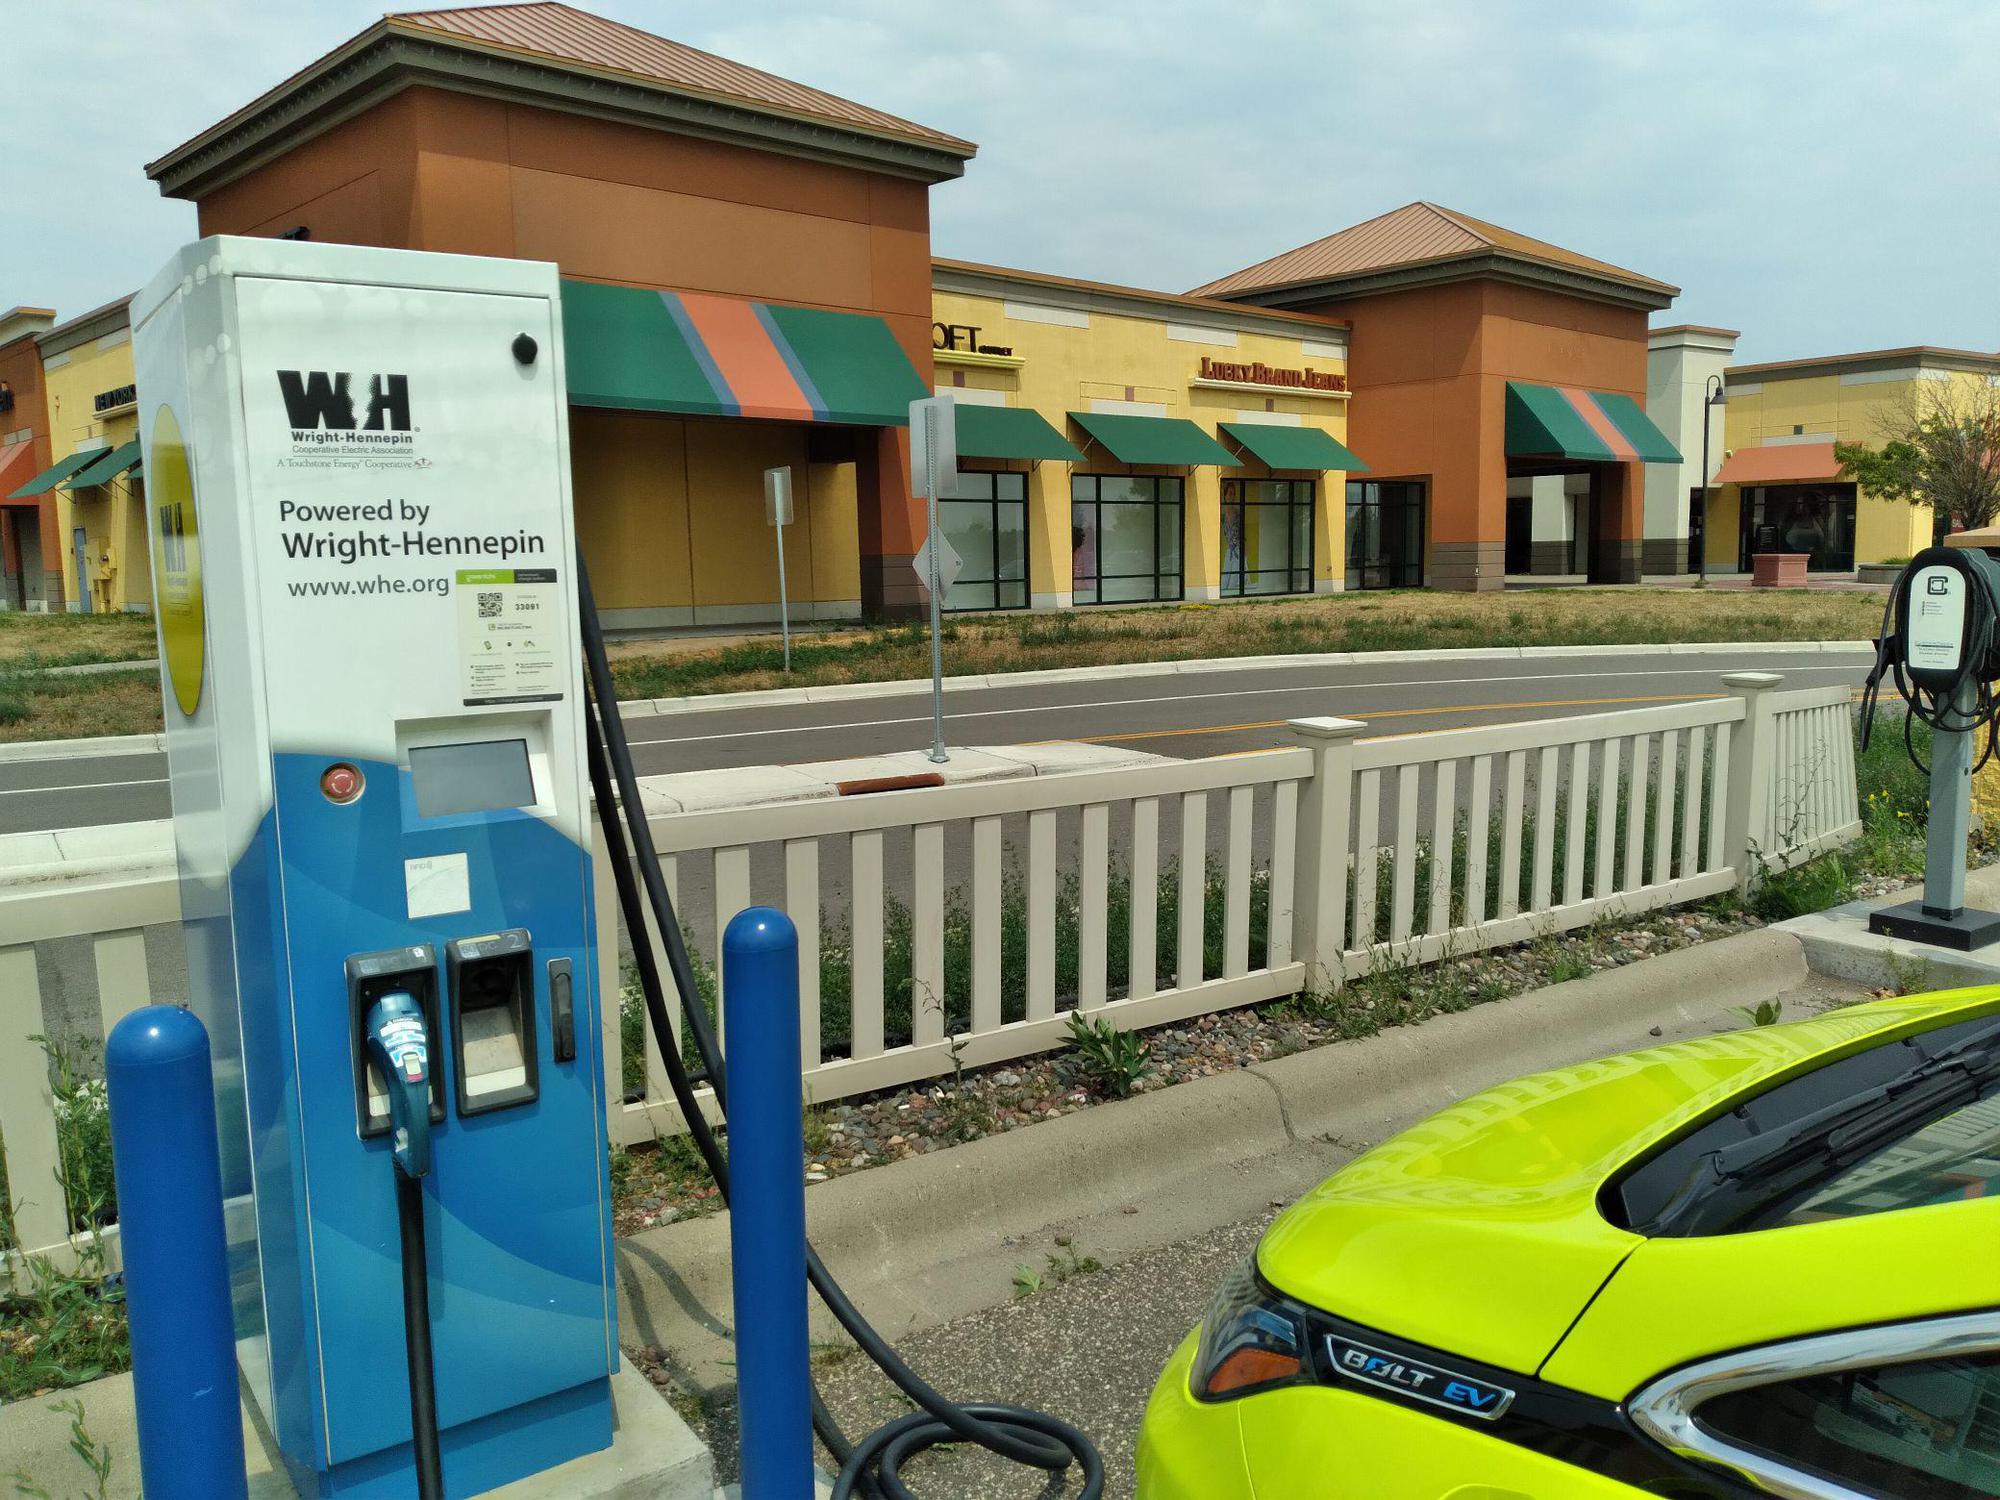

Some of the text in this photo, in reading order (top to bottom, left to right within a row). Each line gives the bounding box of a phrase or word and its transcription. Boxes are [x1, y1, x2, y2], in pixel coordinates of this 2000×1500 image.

[932, 322, 982, 353] OFT
[1201, 357, 1346, 392] LUCKY BRAND JEANS
[291, 431, 413, 445] Wright-Hennepin
[292, 445, 414, 455] Cooperative Electric Association
[277, 460, 285, 468] A
[286, 459, 332, 468] Touchstone
[365, 459, 413, 470] Cooperative
[280, 499, 430, 526] Powered by
[282, 529, 544, 564] Wright-Hennepin
[288, 574, 449, 597] www.whe.org
[507, 934, 524, 949] 2
[1343, 1349, 1496, 1407] BOLT EV
